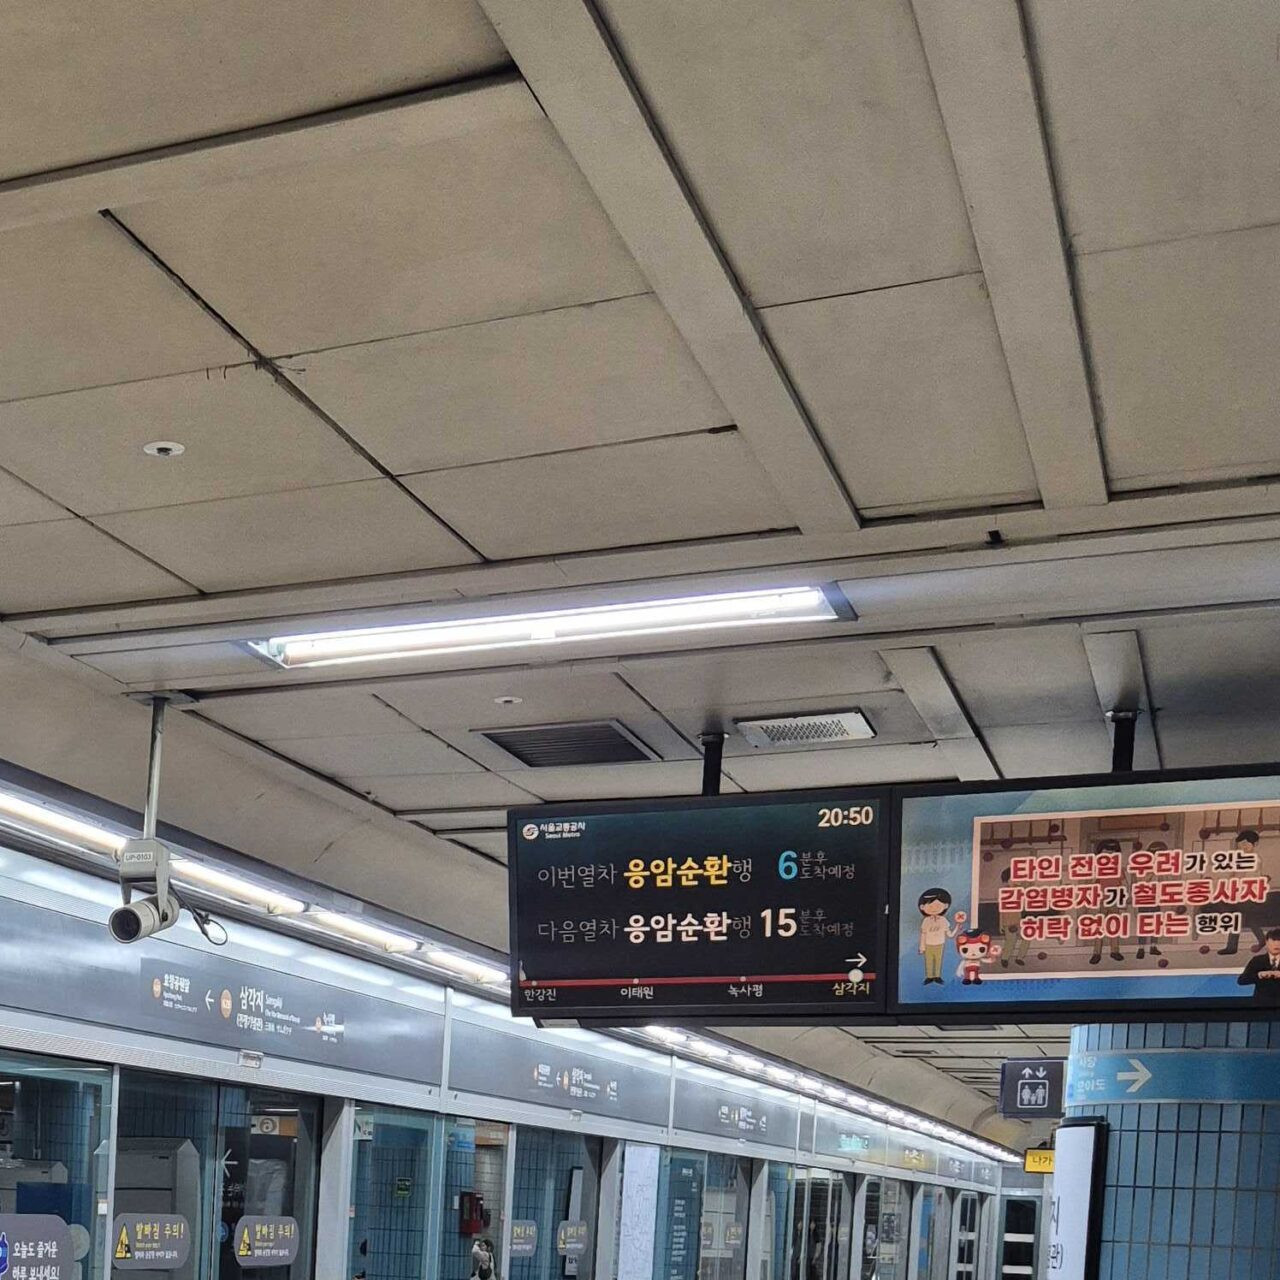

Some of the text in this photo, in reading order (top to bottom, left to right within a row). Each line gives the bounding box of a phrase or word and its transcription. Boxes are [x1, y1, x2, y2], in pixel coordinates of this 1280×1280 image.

[818, 806, 874, 828] 20:50
[537, 862, 616, 889] 이번열차
[778, 850, 799, 880] 6
[799, 864, 856, 880] 도착예정
[1011, 850, 1257, 881] 타인 전염 우려가 있는
[999, 878, 1269, 913] 감염병자가 철도종사자
[537, 917, 621, 944] 다음열차
[760, 907, 798, 938] 15
[799, 921, 854, 938] 도착예정
[1022, 912, 1241, 940] 허락 없이 타는 행위
[239, 986, 264, 1013] 삼각지
[523, 980, 871, 1001] 한강진 이태원 녹사평 삼각지
[12, 1241, 58, 1259] 오늘도 즐거운
